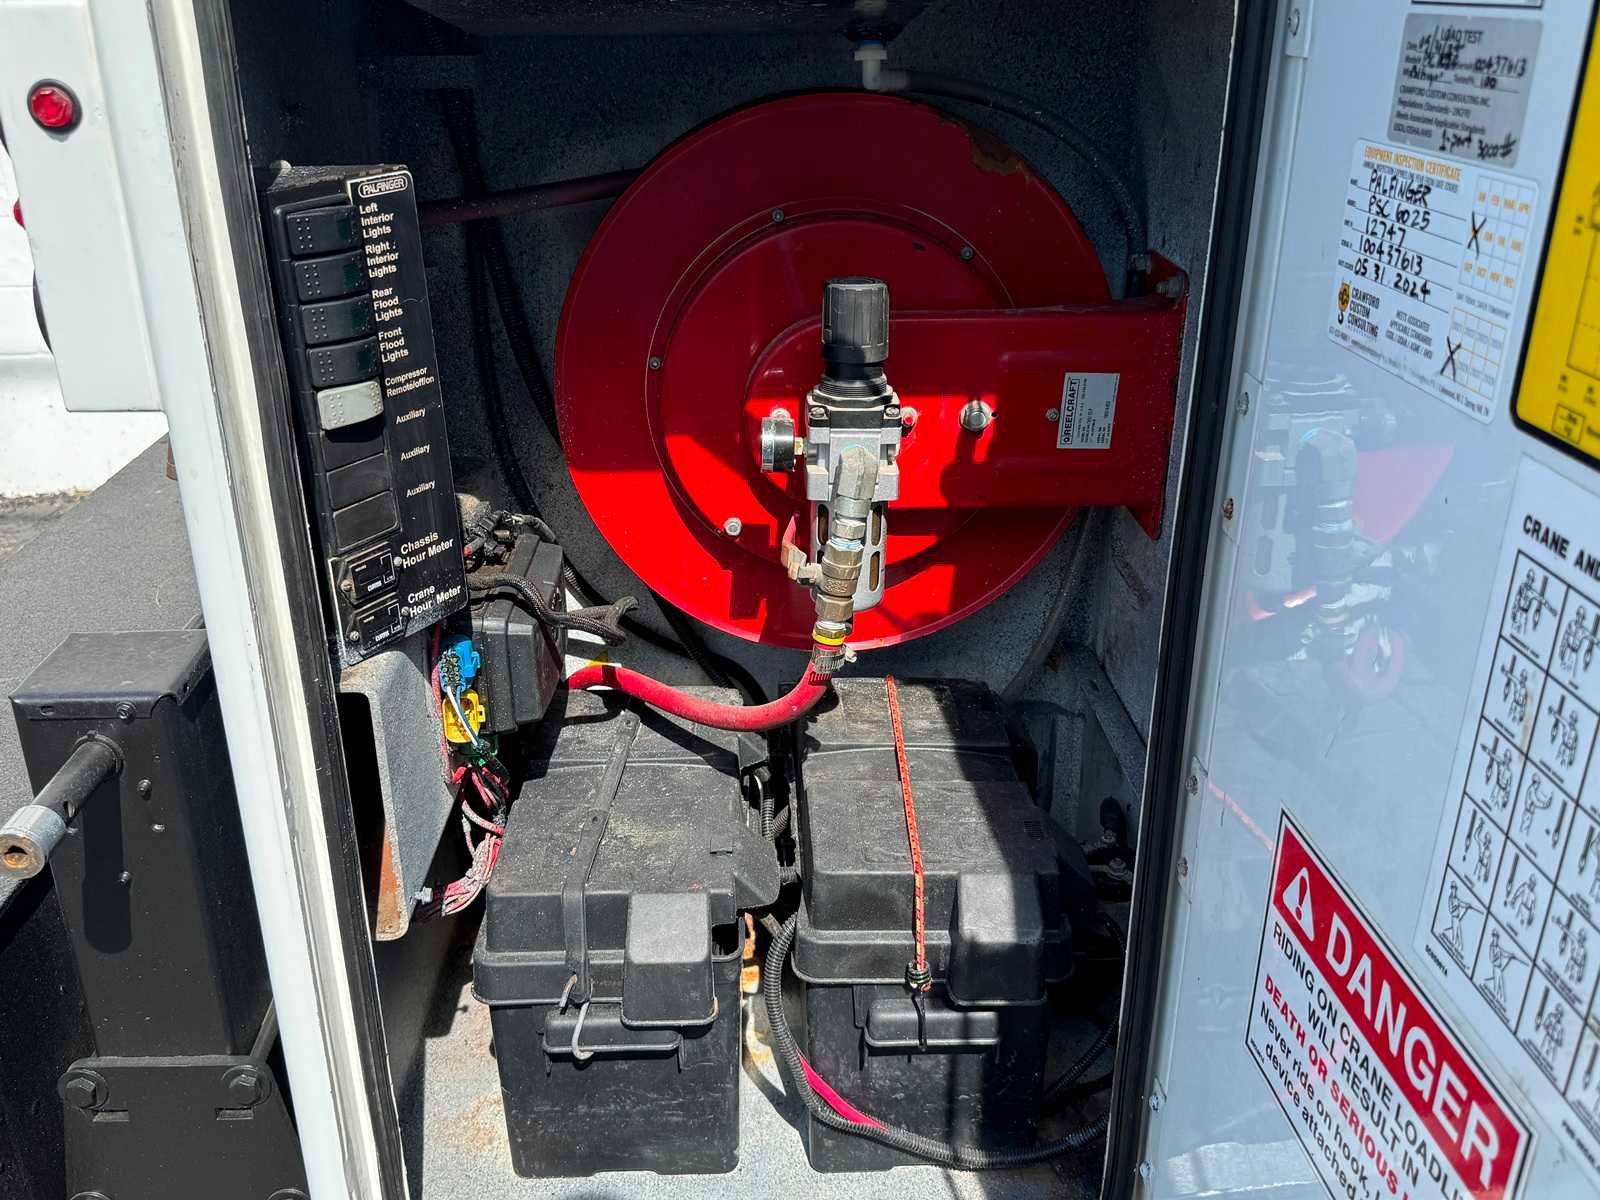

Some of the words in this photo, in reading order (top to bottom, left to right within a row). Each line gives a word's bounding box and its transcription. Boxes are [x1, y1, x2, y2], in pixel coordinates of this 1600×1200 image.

[1462, 30, 1484, 44] TEST
[362, 178, 405, 195] PALFINGER
[1369, 168, 1431, 209] PALFINGER
[359, 202, 378, 215] Left
[1369, 195, 1391, 219] PSC
[361, 212, 394, 227] Interior
[363, 225, 392, 239] Lights
[1366, 216, 1406, 248] 12747
[365, 241, 390, 255] Right
[1359, 235, 1423, 276] 100437613
[366, 252, 400, 267] Interior
[369, 264, 397, 279] Lights
[1355, 258, 1369, 276] 05
[1374, 263, 1386, 285] 31
[1394, 272, 1431, 303] 2024
[372, 287, 393, 299] Rear
[1352, 287, 1380, 310] CRAWFORD
[374, 296, 399, 310] Flood
[1349, 300, 1371, 319] CUSTOM
[375, 308, 404, 322] Lights
[378, 326, 402, 340] Front
[1348, 312, 1379, 338] CONSULTING
[380, 336, 405, 352] Flood
[381, 348, 409, 363] Lights
[384, 367, 428, 386] Compressor
[396, 407, 426, 425] Auxiliary
[400, 444, 430, 461] Auxiliary
[406, 480, 436, 498] Auxiliary
[400, 531, 439, 555] Chassis
[1523, 514, 1570, 560] CRANE
[402, 551, 427, 569] Hour
[428, 538, 454, 557] Meter
[407, 585, 435, 604] Crane
[409, 601, 432, 618] Hour
[436, 584, 461, 604] Meter
[1273, 921, 1315, 994] RIDING
[1317, 988, 1338, 1028] ON
[1340, 1021, 1393, 1111] CRANE
[1325, 911, 1500, 1189] DANGER
[1265, 1043, 1300, 1107] device
[1265, 973, 1306, 1048] DEATH
[1308, 1044, 1328, 1084] OR
[1330, 1079, 1398, 1195] SERIOUS
[1260, 1001, 1291, 1059] Never
[1292, 1057, 1314, 1100] ride
[1316, 1100, 1331, 1131] on
[1334, 1125, 1370, 1199] hook,
[1308, 1001, 1337, 1064] WILL
[1341, 1056, 1400, 1152] RESULT
[1401, 1149, 1419, 1188] IN
